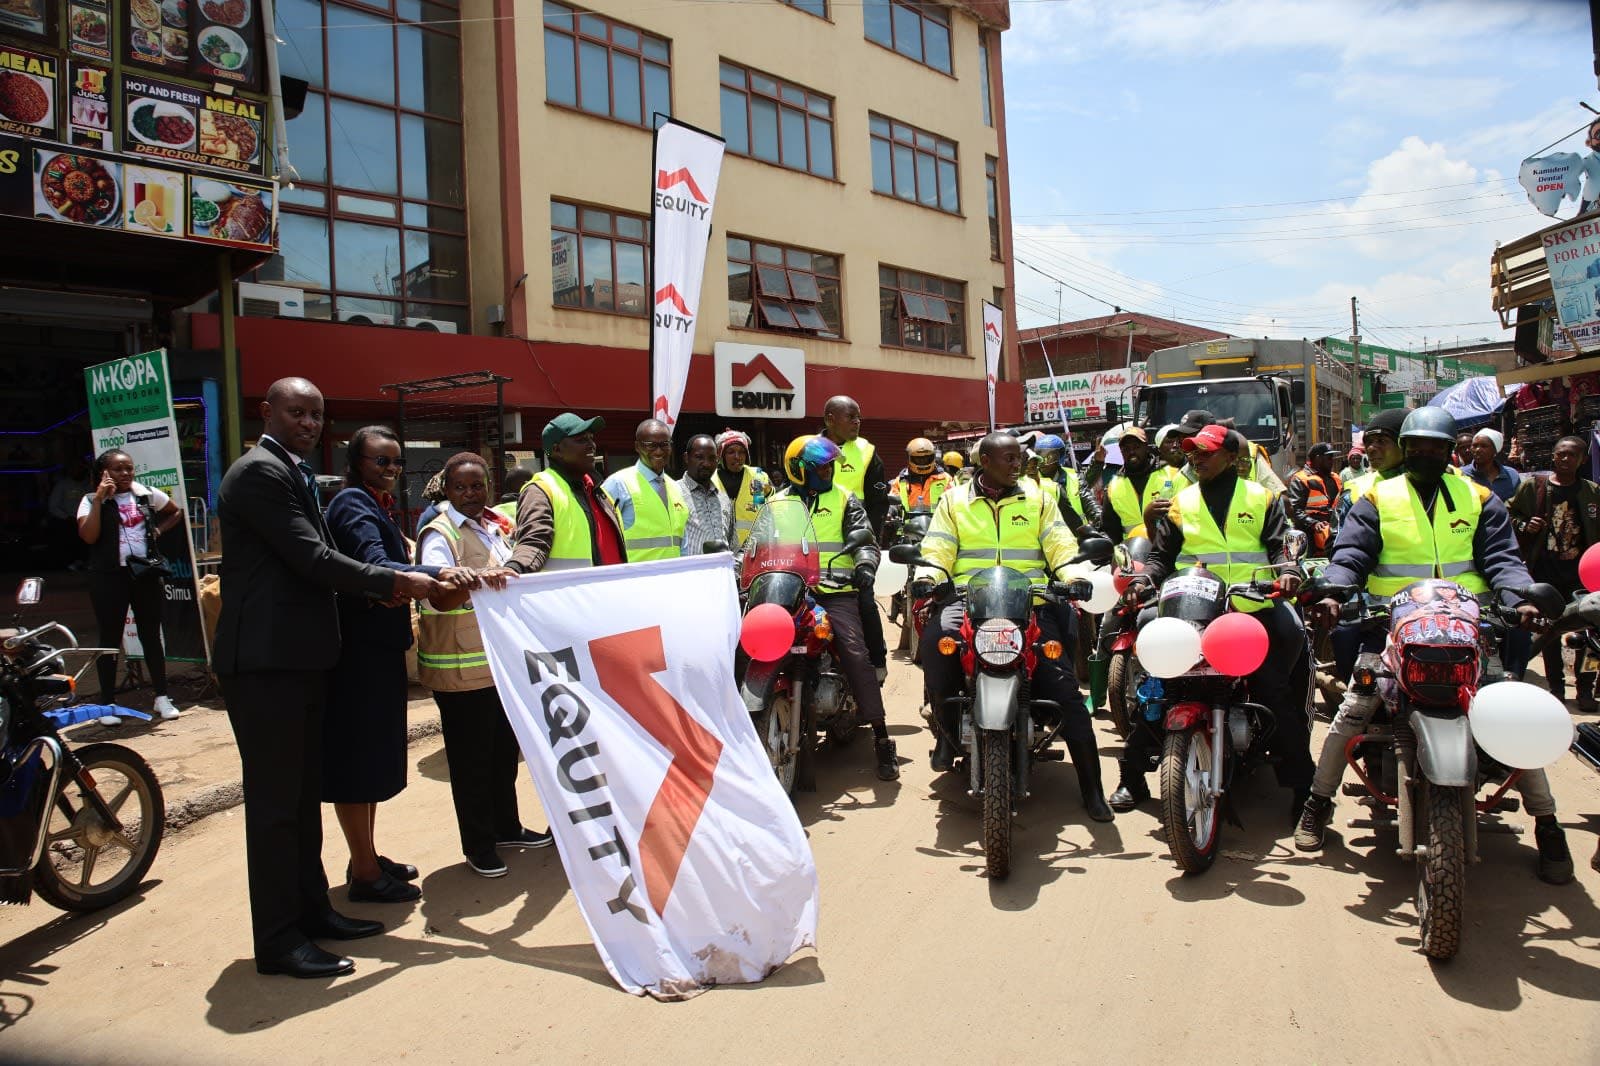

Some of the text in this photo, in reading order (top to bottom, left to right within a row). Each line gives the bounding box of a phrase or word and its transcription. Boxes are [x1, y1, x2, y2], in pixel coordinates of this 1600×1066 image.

[126, 80, 200, 104] HOT AND FRESH
[206, 96, 260, 120] MEAL
[135, 145, 250, 171] DELICIOUS MEALS
[1536, 183, 1563, 192] OPEN
[656, 192, 709, 220] EQUITY
[1553, 249, 1579, 263] FOR
[92, 357, 158, 394] M-KOPA
[1039, 379, 1090, 393] SAMIRA
[732, 391, 795, 410] EQUITY
[760, 559, 793, 569] NGUVU
[164, 584, 192, 600] Simu
[524, 646, 650, 924] EQUITY
